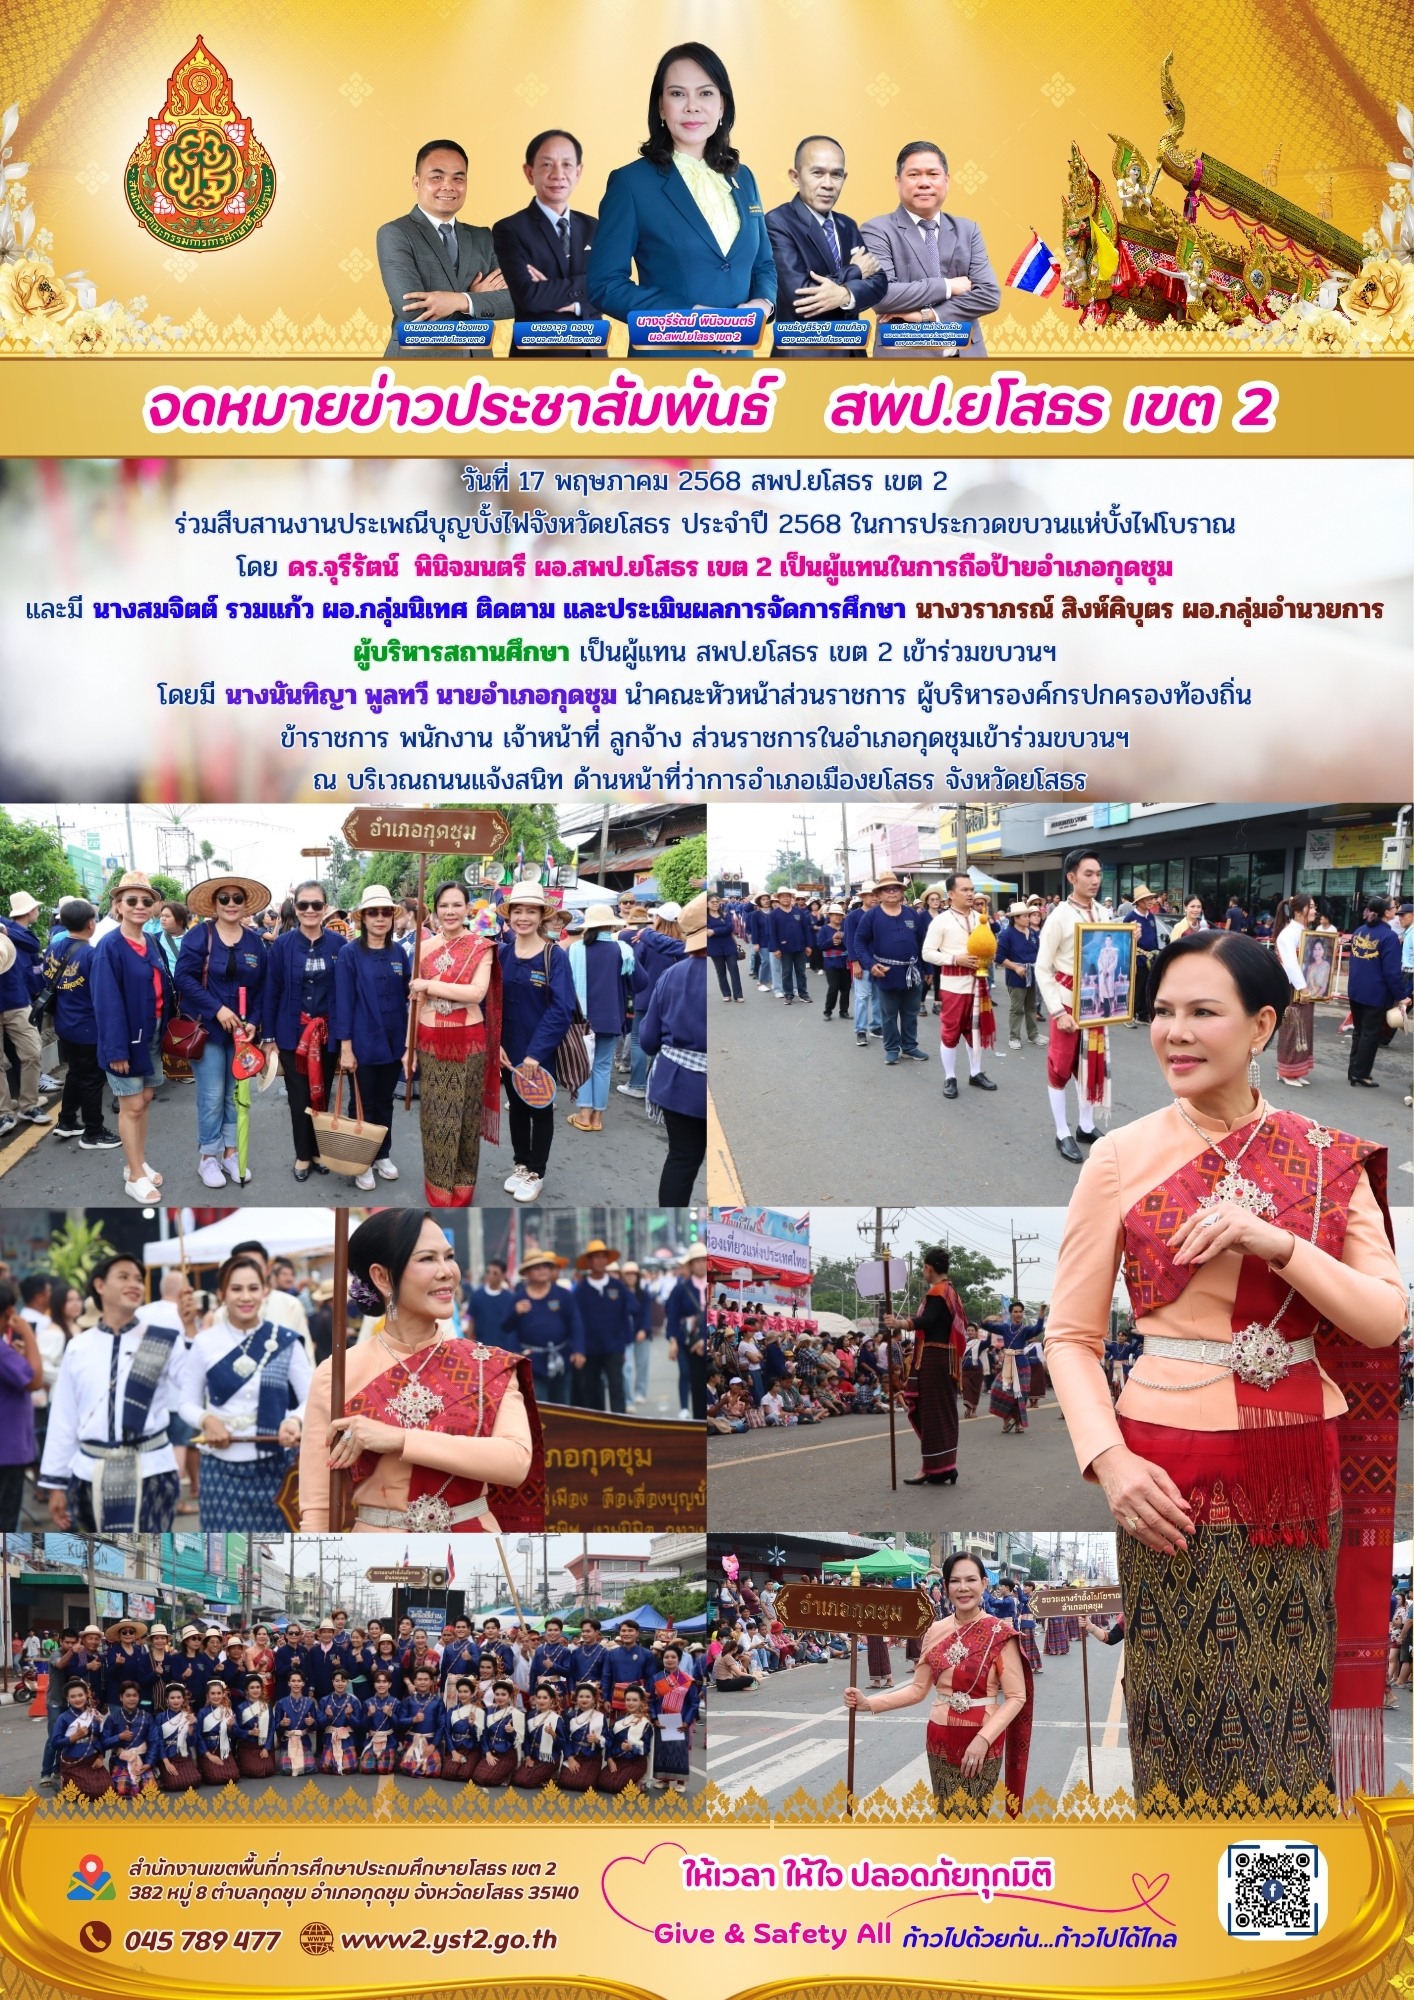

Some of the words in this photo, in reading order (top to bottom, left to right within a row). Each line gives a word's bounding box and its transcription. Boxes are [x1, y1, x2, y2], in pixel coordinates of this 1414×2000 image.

[370, 816, 477, 848] อำเภอกุดชุม
[800, 1593, 903, 1629] อำเภอกุดชุม
